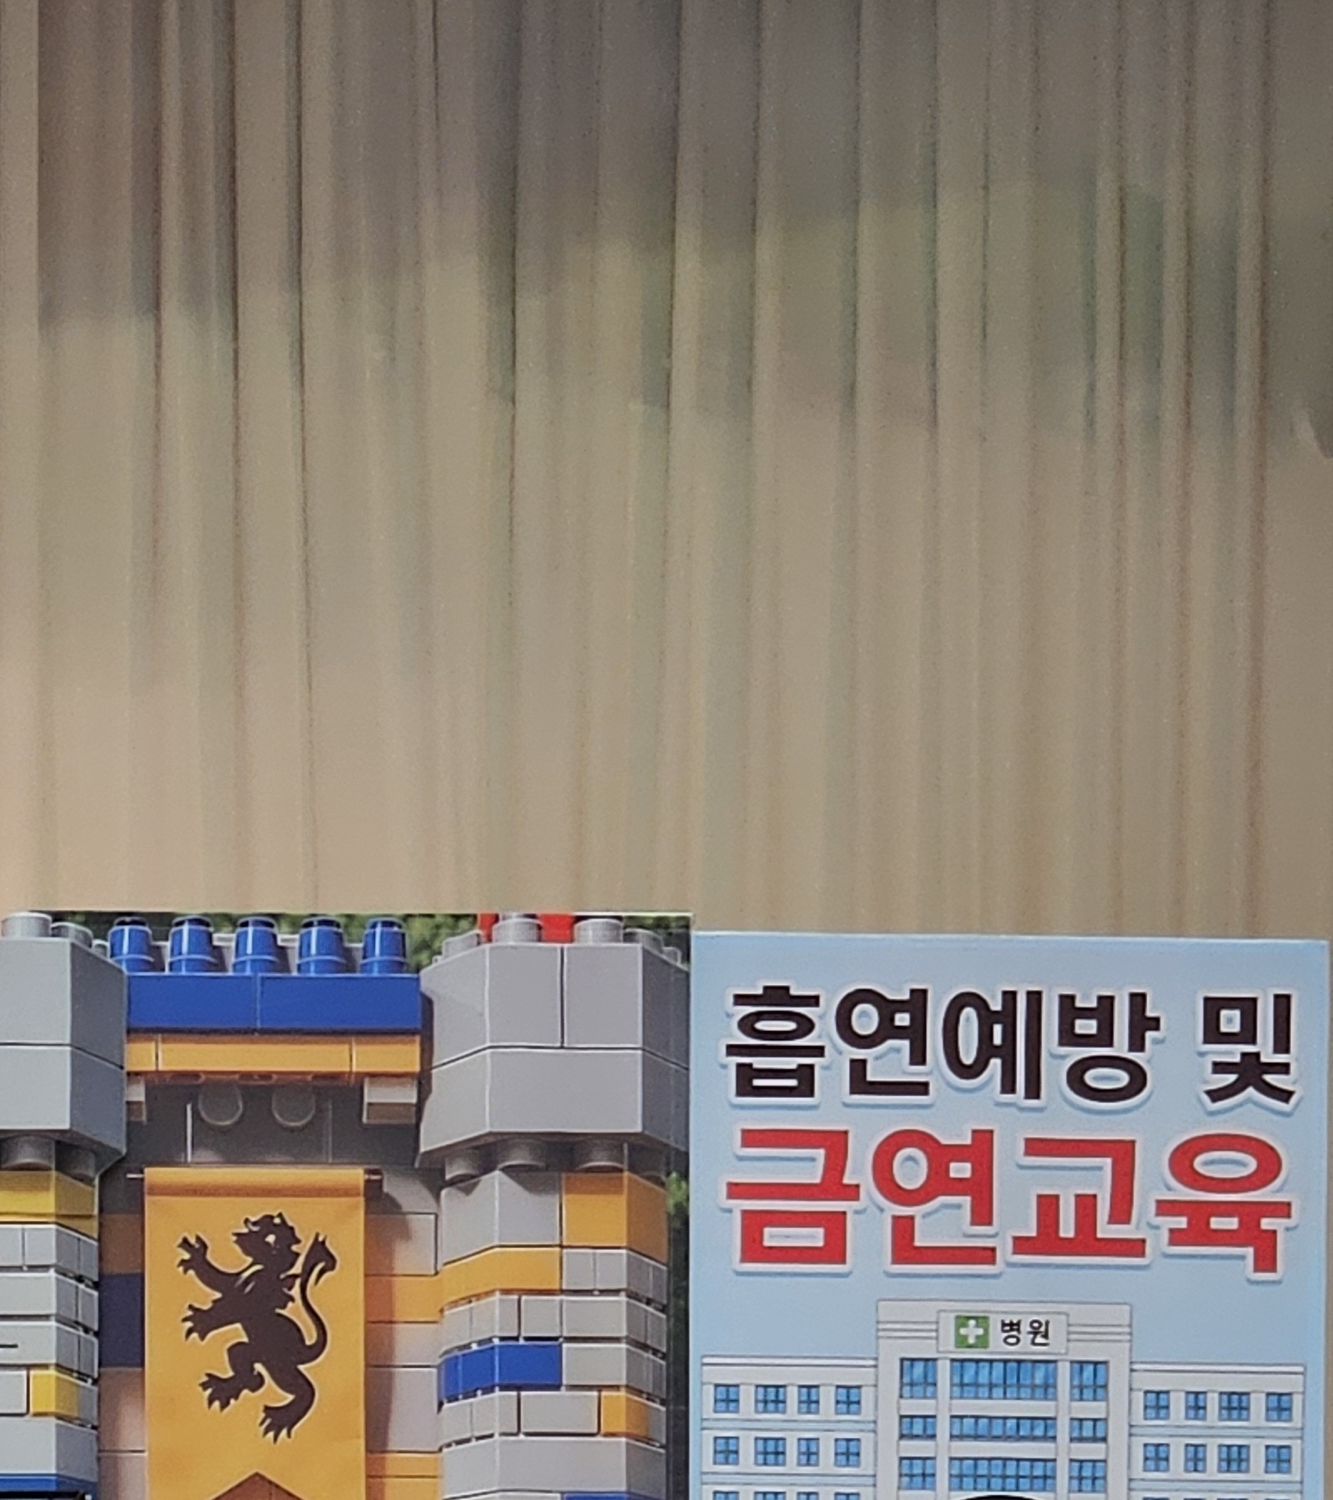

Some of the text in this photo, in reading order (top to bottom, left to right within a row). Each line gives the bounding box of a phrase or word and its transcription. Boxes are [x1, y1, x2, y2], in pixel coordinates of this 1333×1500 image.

[724, 983, 1297, 1106] 흡연예방 및
[724, 1127, 1293, 1276] 금연교육
[1000, 1318, 1051, 1348] 병원
